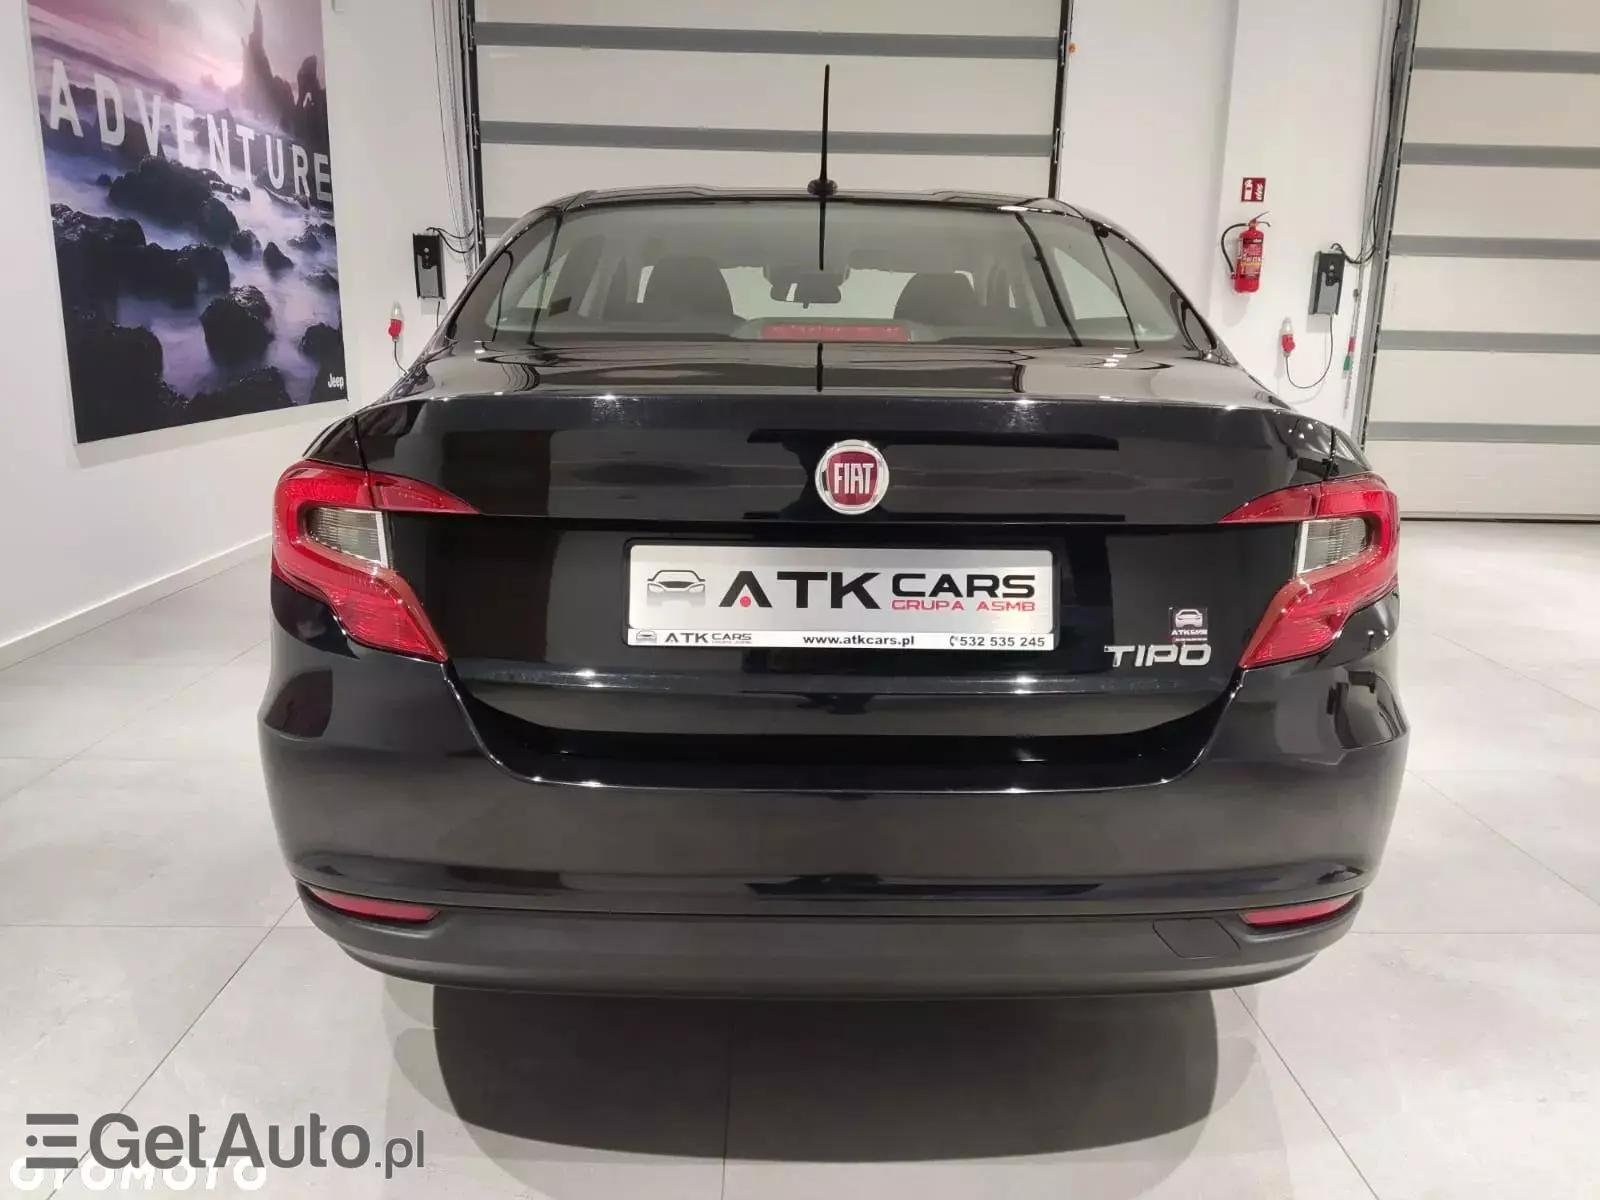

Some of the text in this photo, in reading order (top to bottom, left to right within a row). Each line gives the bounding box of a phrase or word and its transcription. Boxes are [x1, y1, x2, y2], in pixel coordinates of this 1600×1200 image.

[49, 58, 332, 200] ADVENTURE
[327, 372, 344, 391] Jeep
[833, 462, 874, 495] FIAT
[718, 570, 1036, 609] ATK CARS
[891, 599, 1036, 612] GRUPA ASMB
[664, 632, 709, 644] ATK
[711, 633, 752, 641] CARS
[802, 635, 915, 648] www.atkcars.pl
[959, 635, 1046, 648] 532 535 245
[1103, 643, 1212, 668] TIPO
